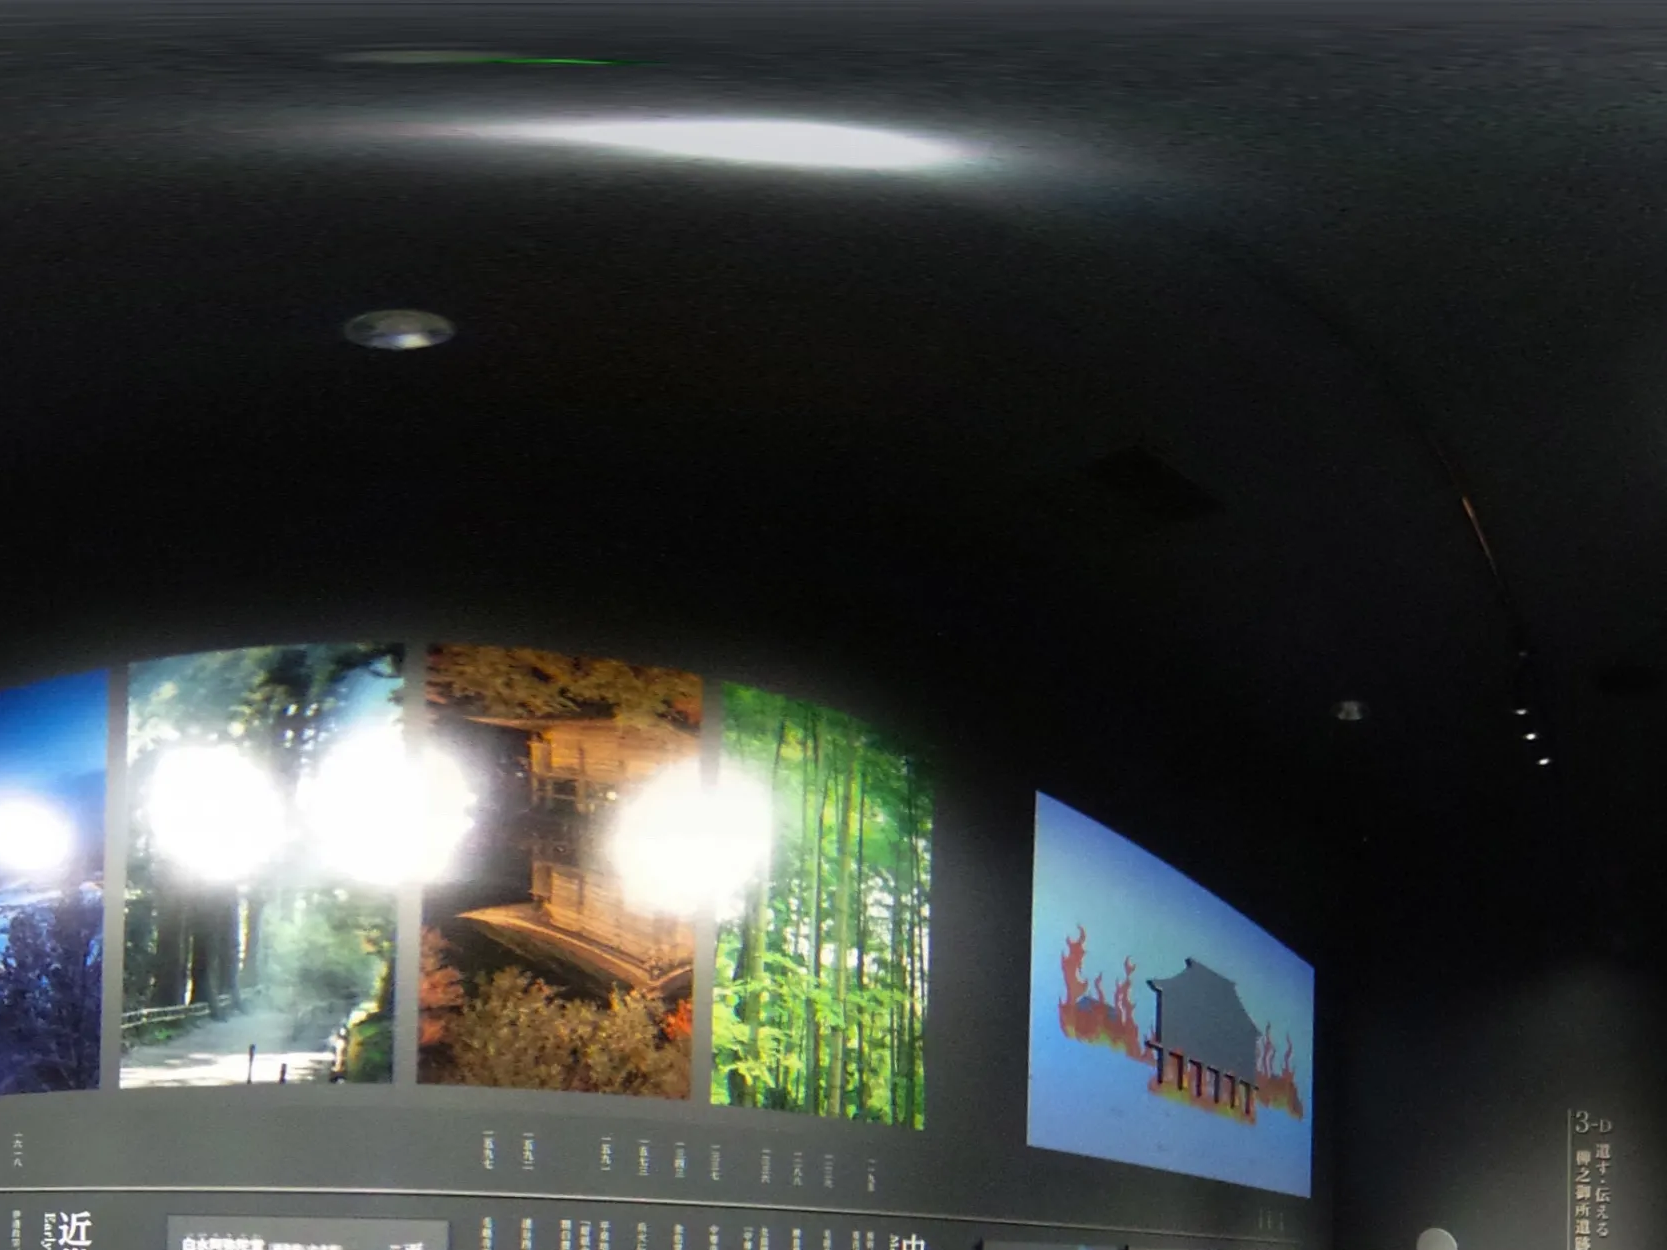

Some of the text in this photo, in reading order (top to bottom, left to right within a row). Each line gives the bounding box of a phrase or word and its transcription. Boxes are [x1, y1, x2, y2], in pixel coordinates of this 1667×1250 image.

[1594, 1143, 1611, 1237] 遺す・伝える
[41, 1212, 57, 1250] Early
